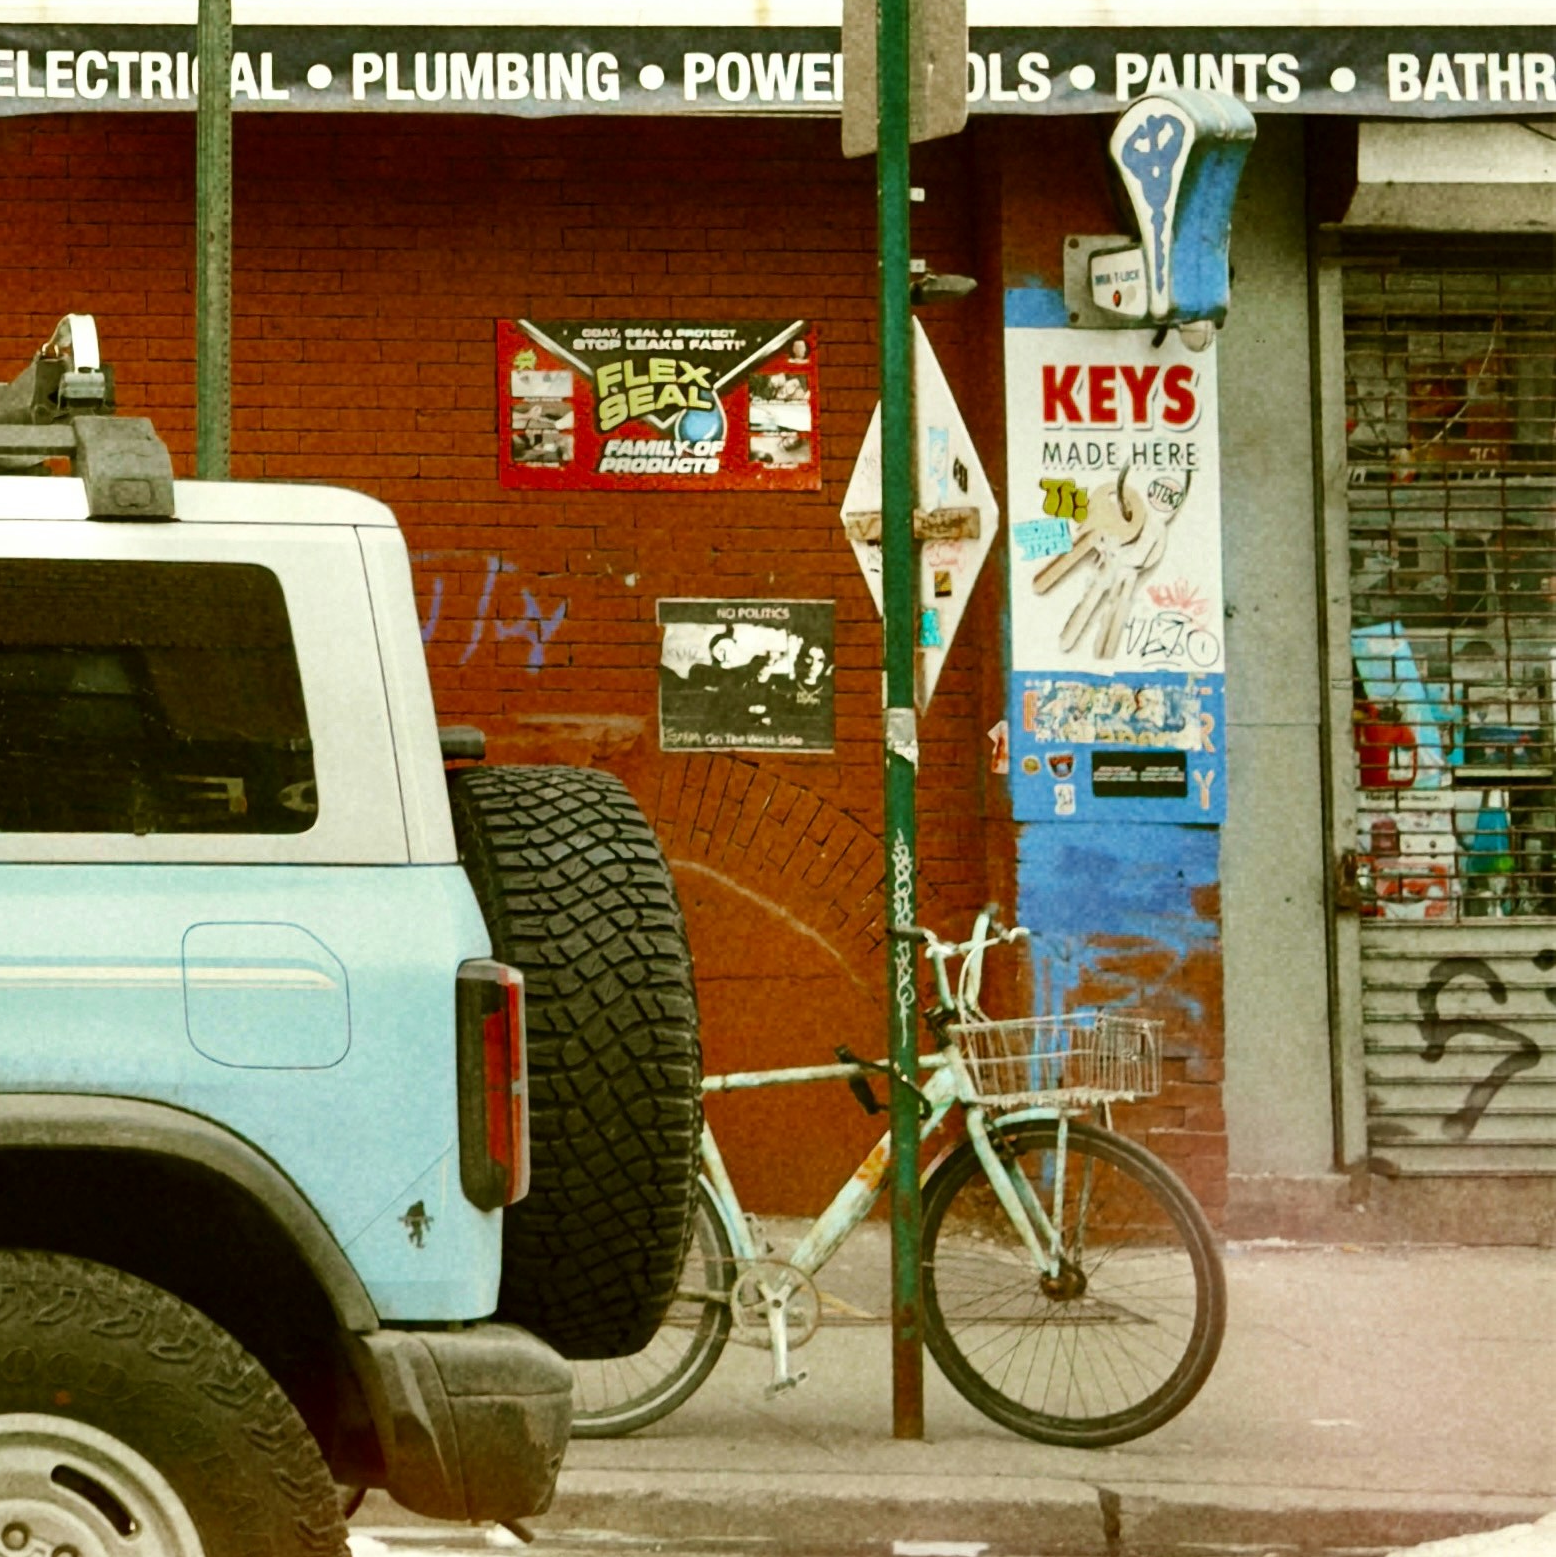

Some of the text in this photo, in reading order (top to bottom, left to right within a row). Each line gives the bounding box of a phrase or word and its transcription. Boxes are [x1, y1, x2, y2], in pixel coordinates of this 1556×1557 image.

[352, 51, 620, 101] PLUMBING
[684, 51, 844, 101] POWE
[1116, 52, 1301, 103] PAINTS
[624, 327, 660, 338] SEAL
[675, 328, 737, 338] PROTECT
[572, 338, 622, 351] STOP
[625, 338, 685, 351] LEAKS
[596, 357, 713, 399] FLEX
[1041, 364, 1197, 426] KEYS
[598, 383, 714, 431] SEAL
[604, 439, 726, 457] FAMILY OF
[1042, 442, 1197, 466] MADE HERE
[598, 457, 721, 475] PRODUCTS
[716, 608, 790, 620] NO POLITICS
